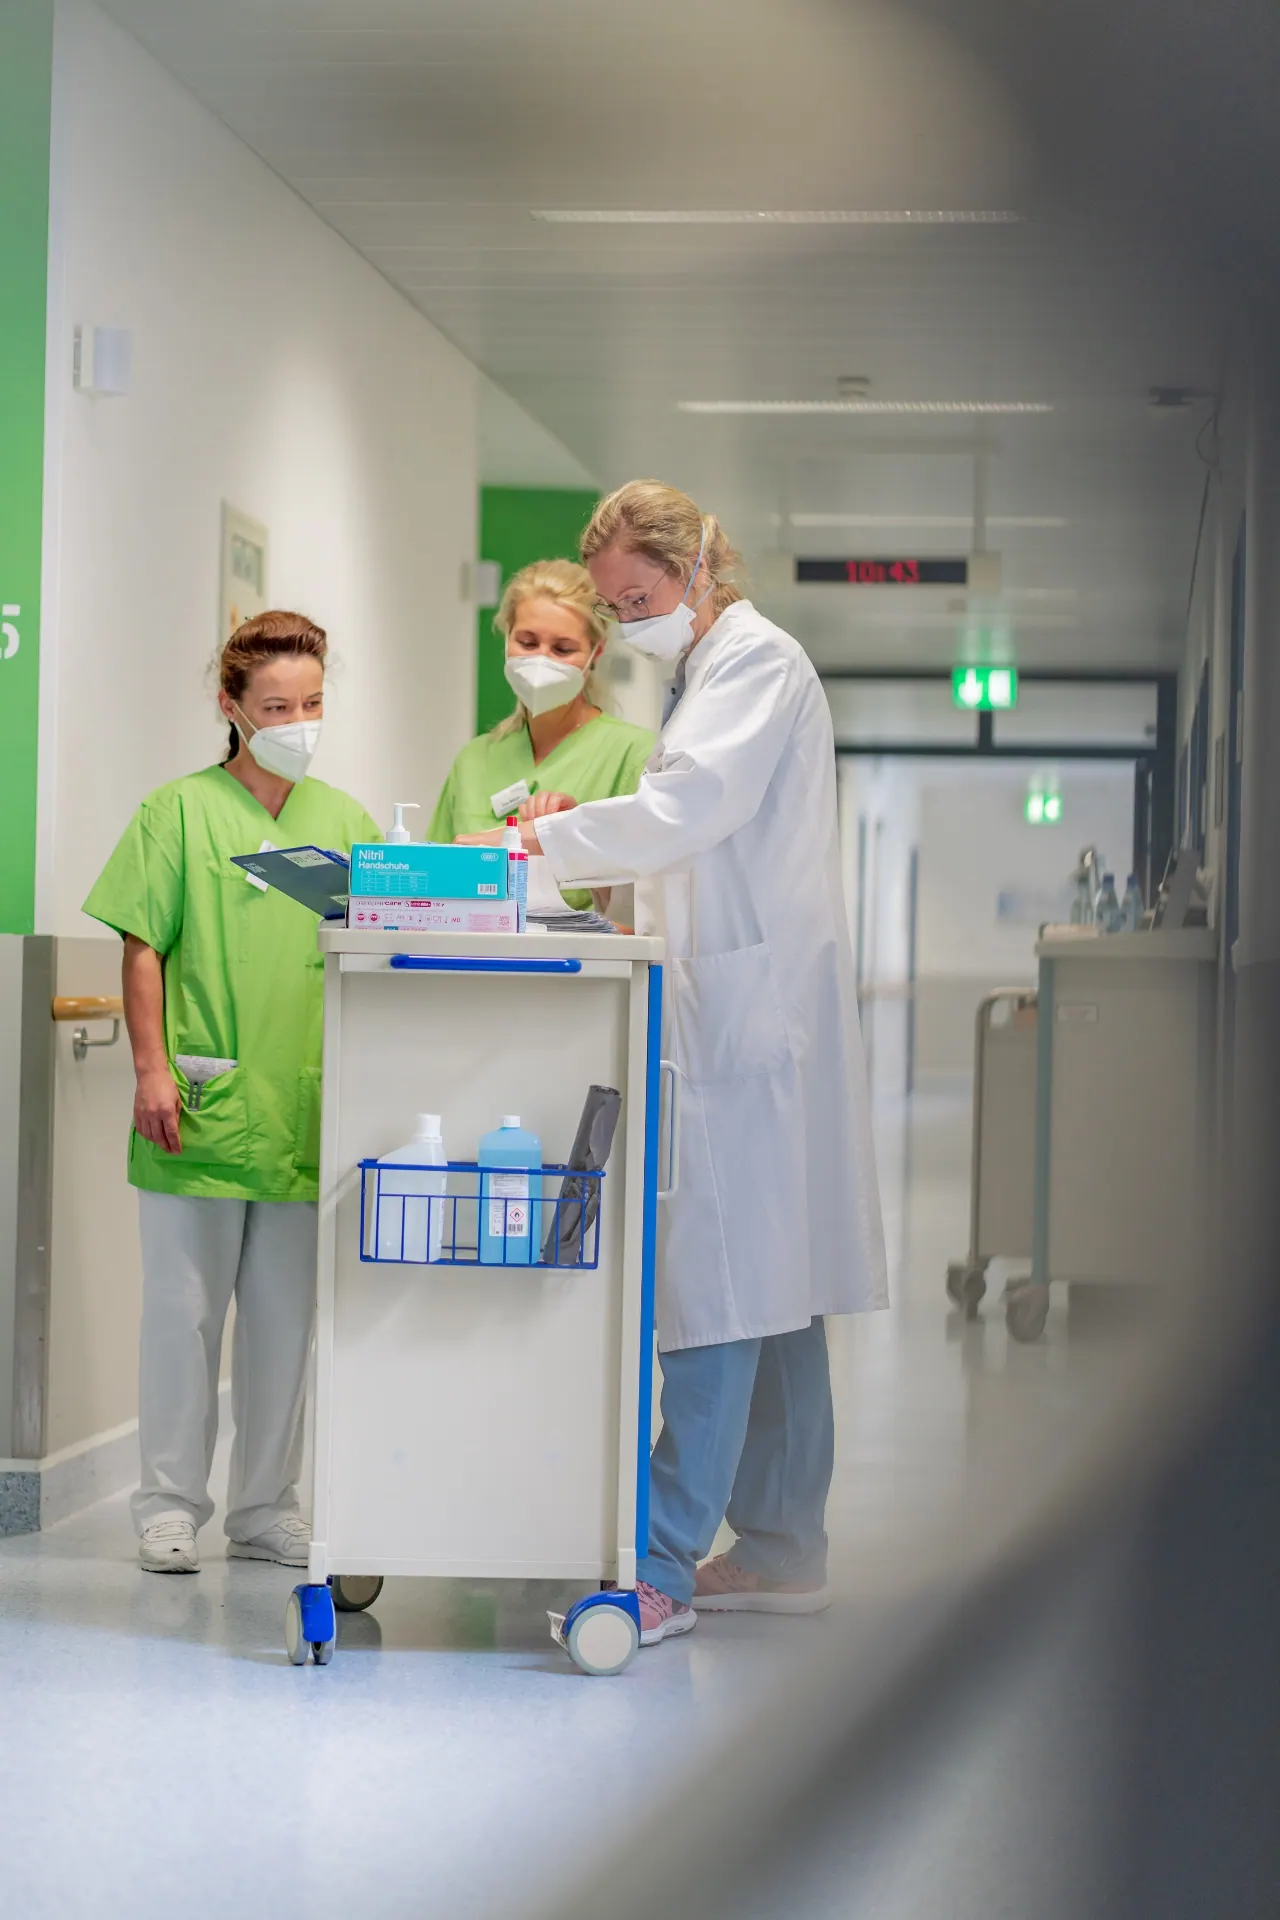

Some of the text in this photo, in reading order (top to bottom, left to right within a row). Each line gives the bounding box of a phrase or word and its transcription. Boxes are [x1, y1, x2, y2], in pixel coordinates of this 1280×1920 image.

[0, 603, 21, 660] 5
[358, 849, 384, 861] Nitril
[358, 861, 410, 871] Handschuhe
